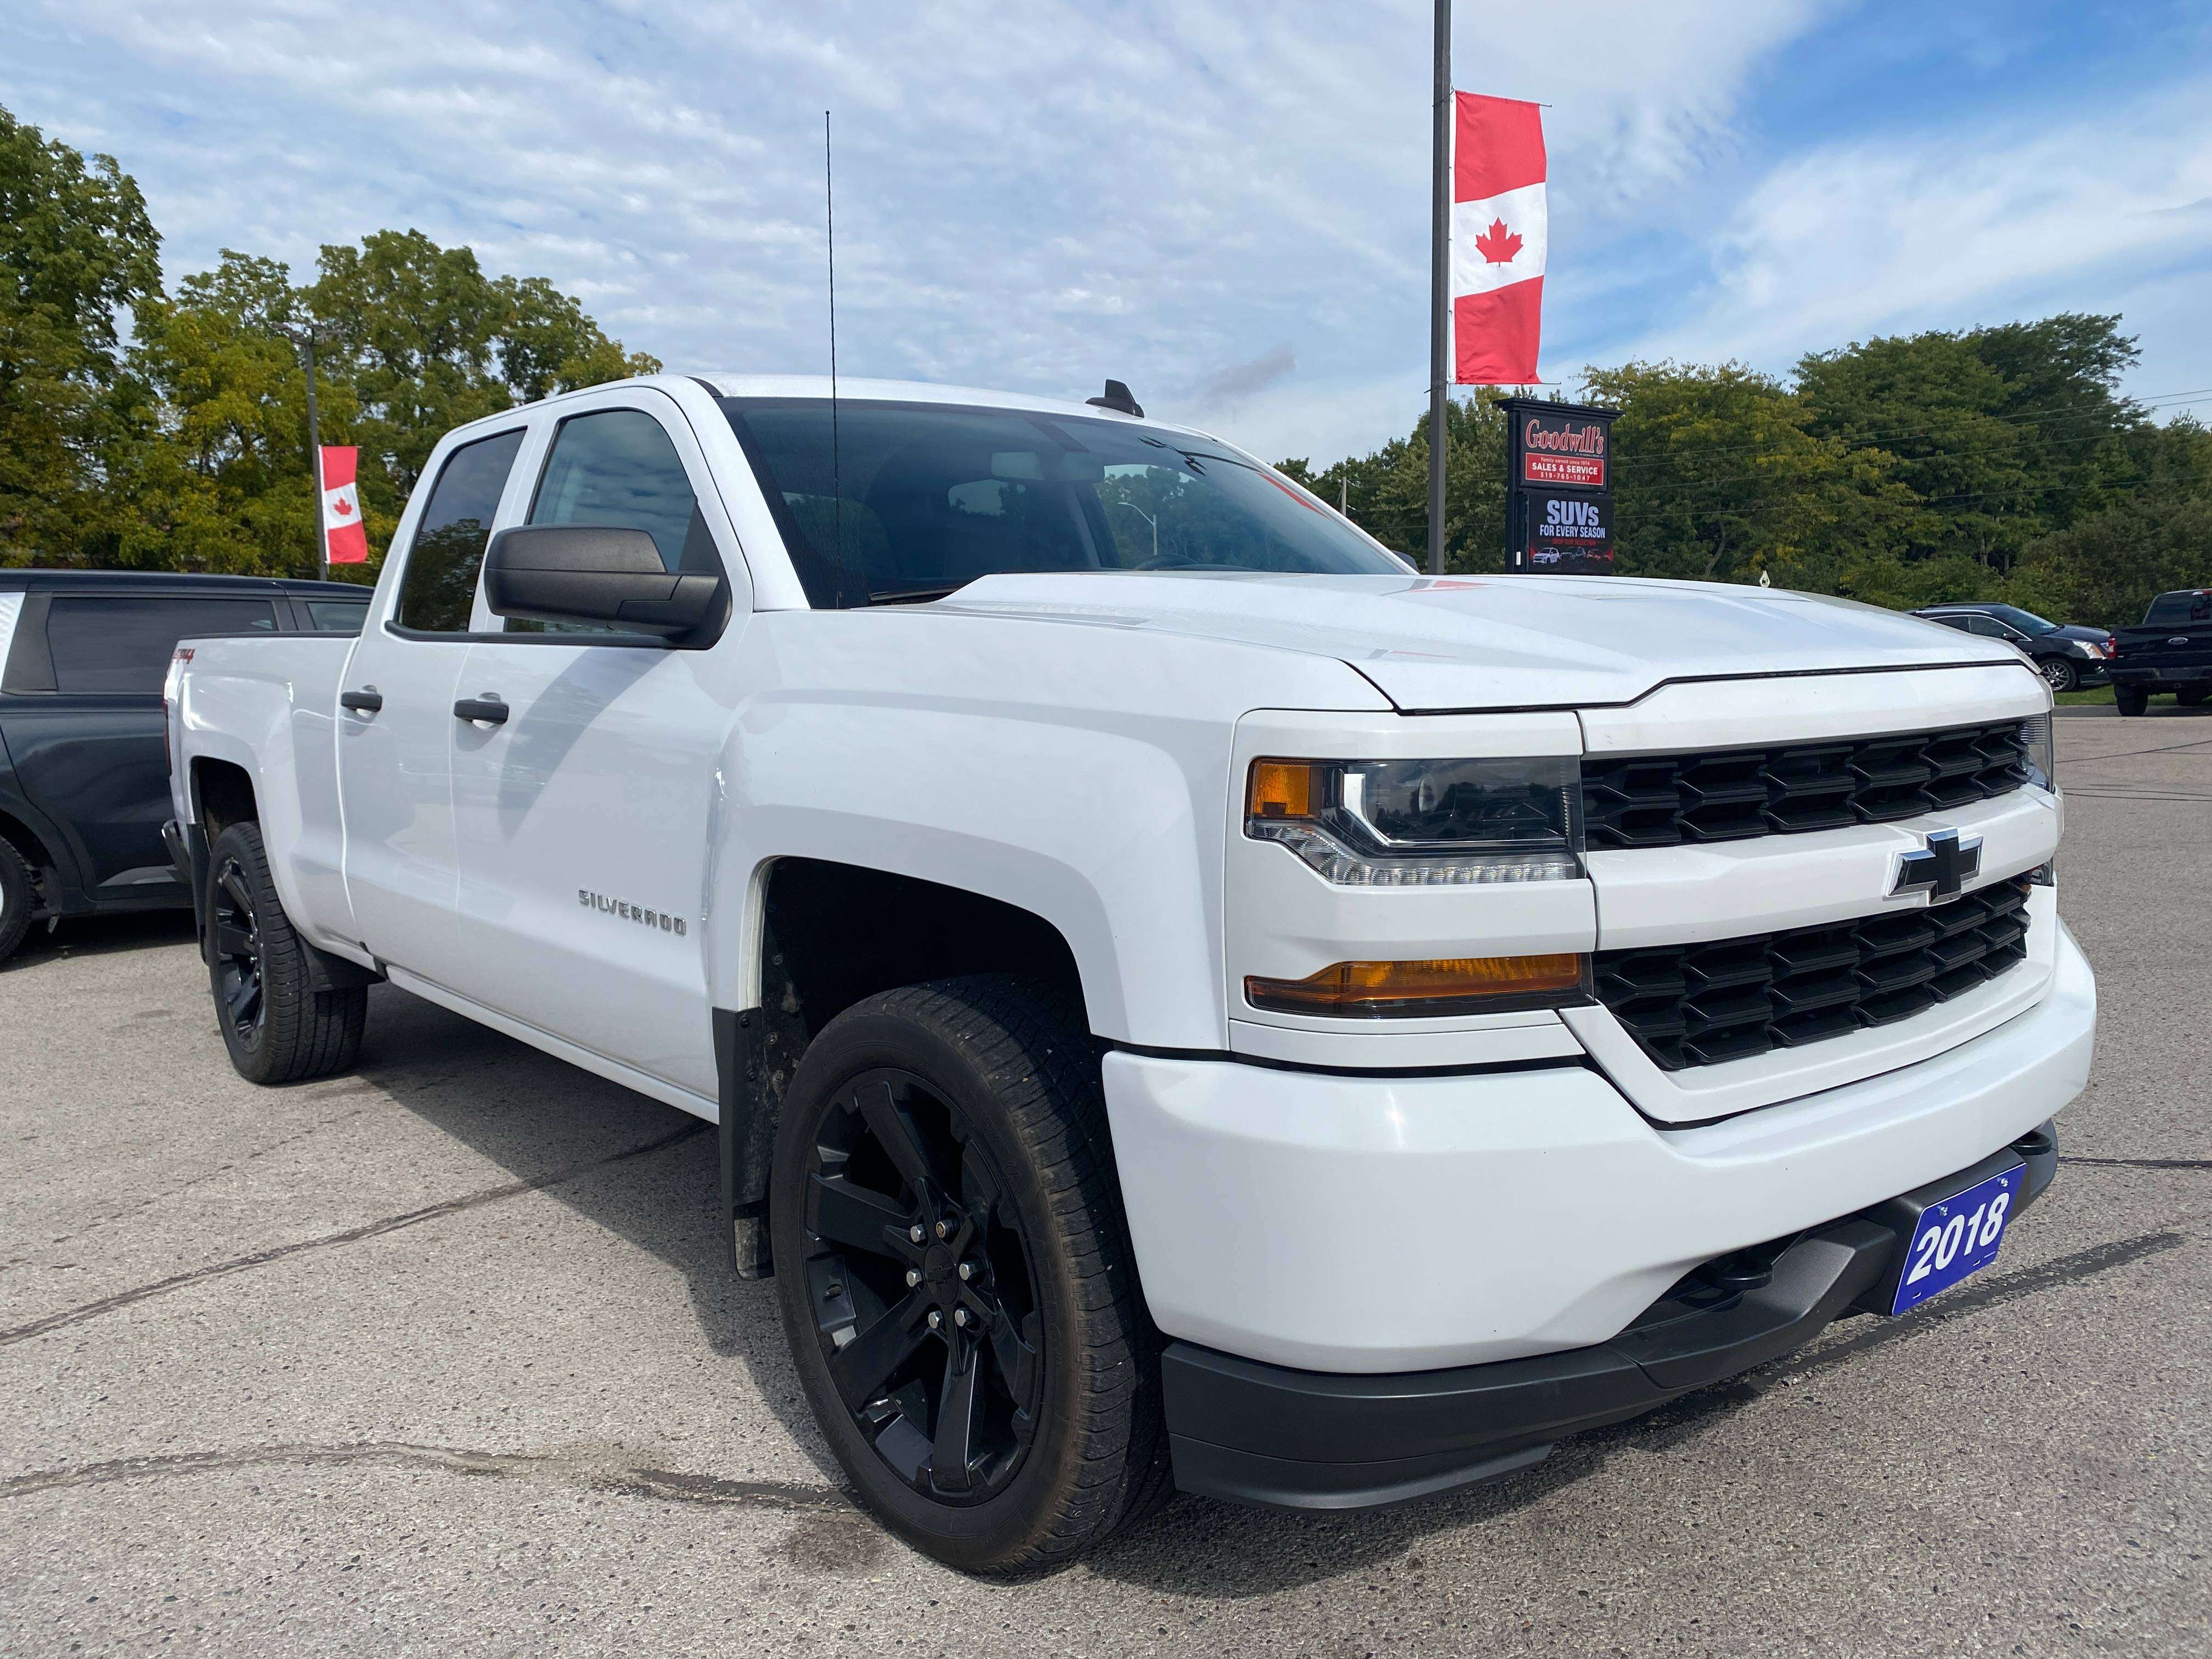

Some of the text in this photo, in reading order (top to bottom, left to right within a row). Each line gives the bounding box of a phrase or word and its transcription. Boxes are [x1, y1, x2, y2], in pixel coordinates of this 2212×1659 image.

[1526, 419, 1604, 454] Goodwill's
[1532, 462, 1556, 471] SALES
[1566, 465, 1598, 475] SERVICE
[1541, 472, 1590, 481] 519-765-1047
[1547, 499, 1599, 526] SUVs
[1539, 524, 1605, 538] FOR EVERY SEASON
[579, 889, 686, 935] SILVERADO
[1906, 1192, 2010, 1286] 2018
